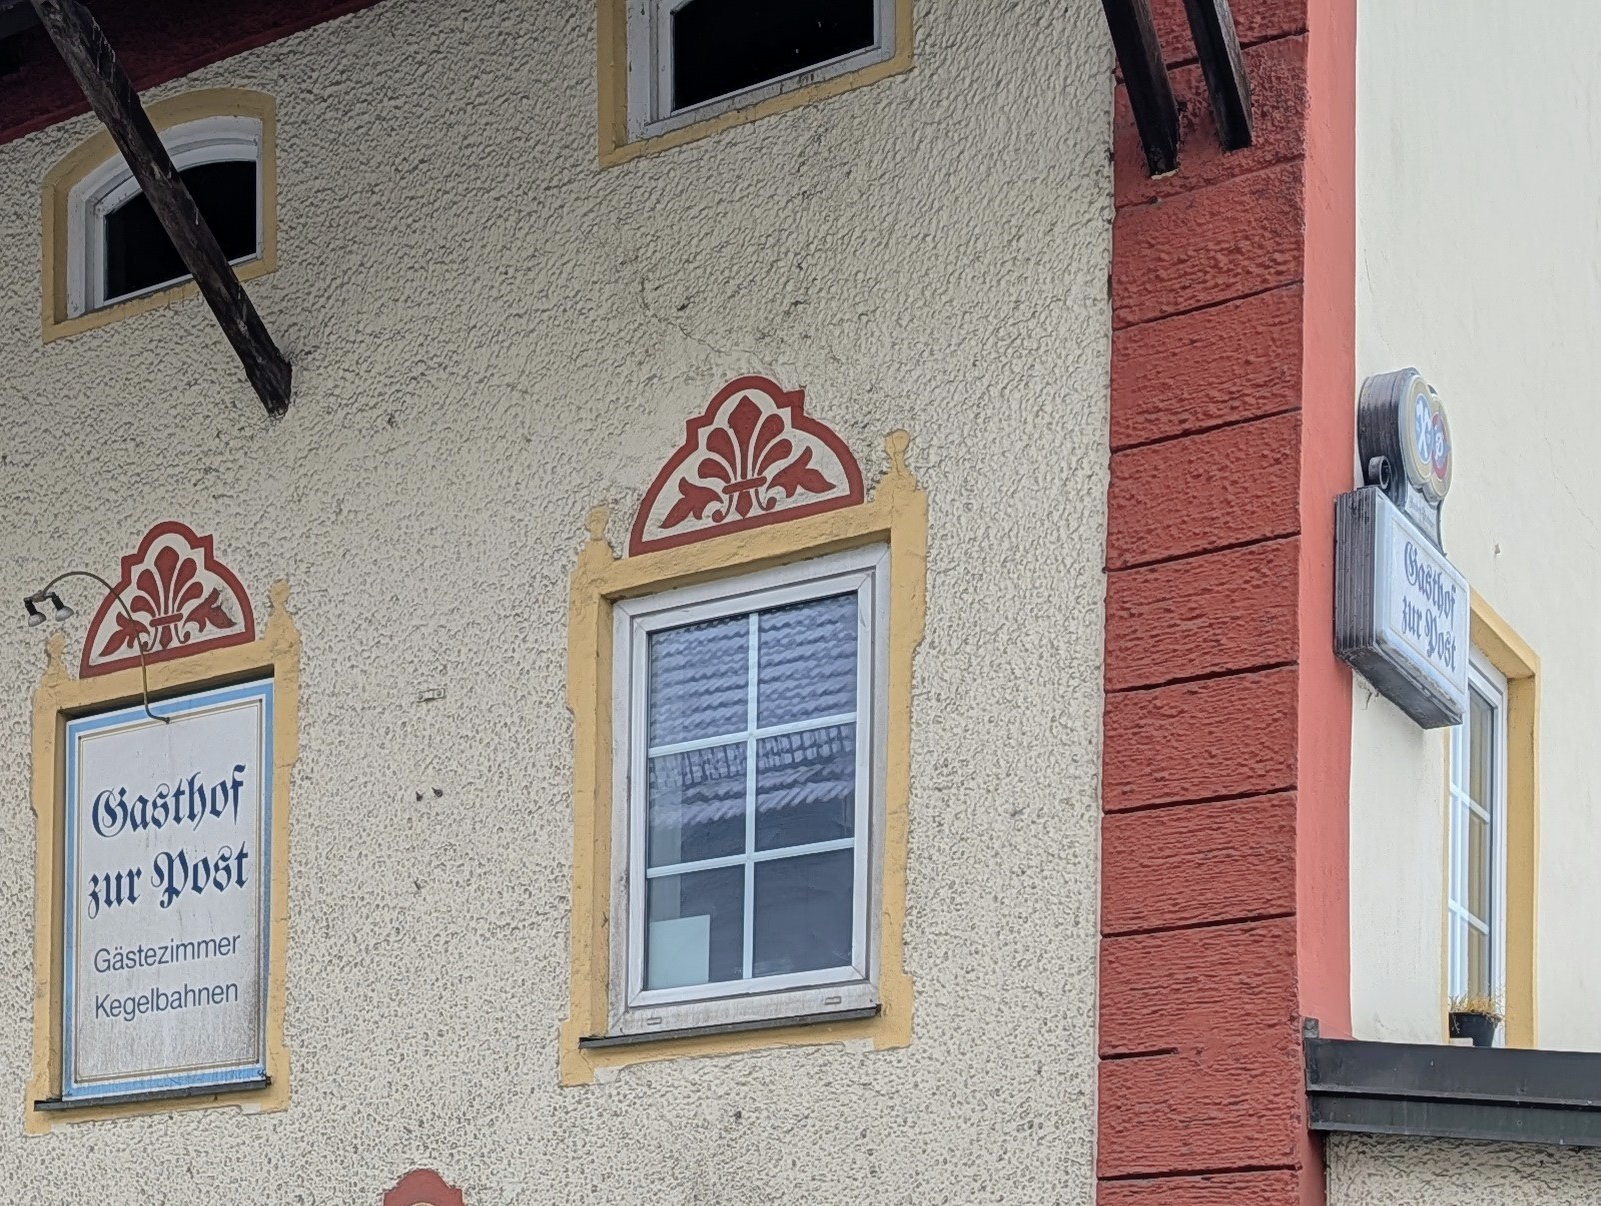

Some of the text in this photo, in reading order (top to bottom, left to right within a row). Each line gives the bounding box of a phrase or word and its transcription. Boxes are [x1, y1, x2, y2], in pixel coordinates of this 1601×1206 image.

[1404, 541, 1456, 631] Gasthof
[1401, 595, 1456, 673] zur Post
[91, 764, 246, 838] Gasthof
[87, 840, 249, 920] zur Post
[93, 934, 241, 973] Gästezimmer
[95, 982, 239, 1022] Kegelbahnen
